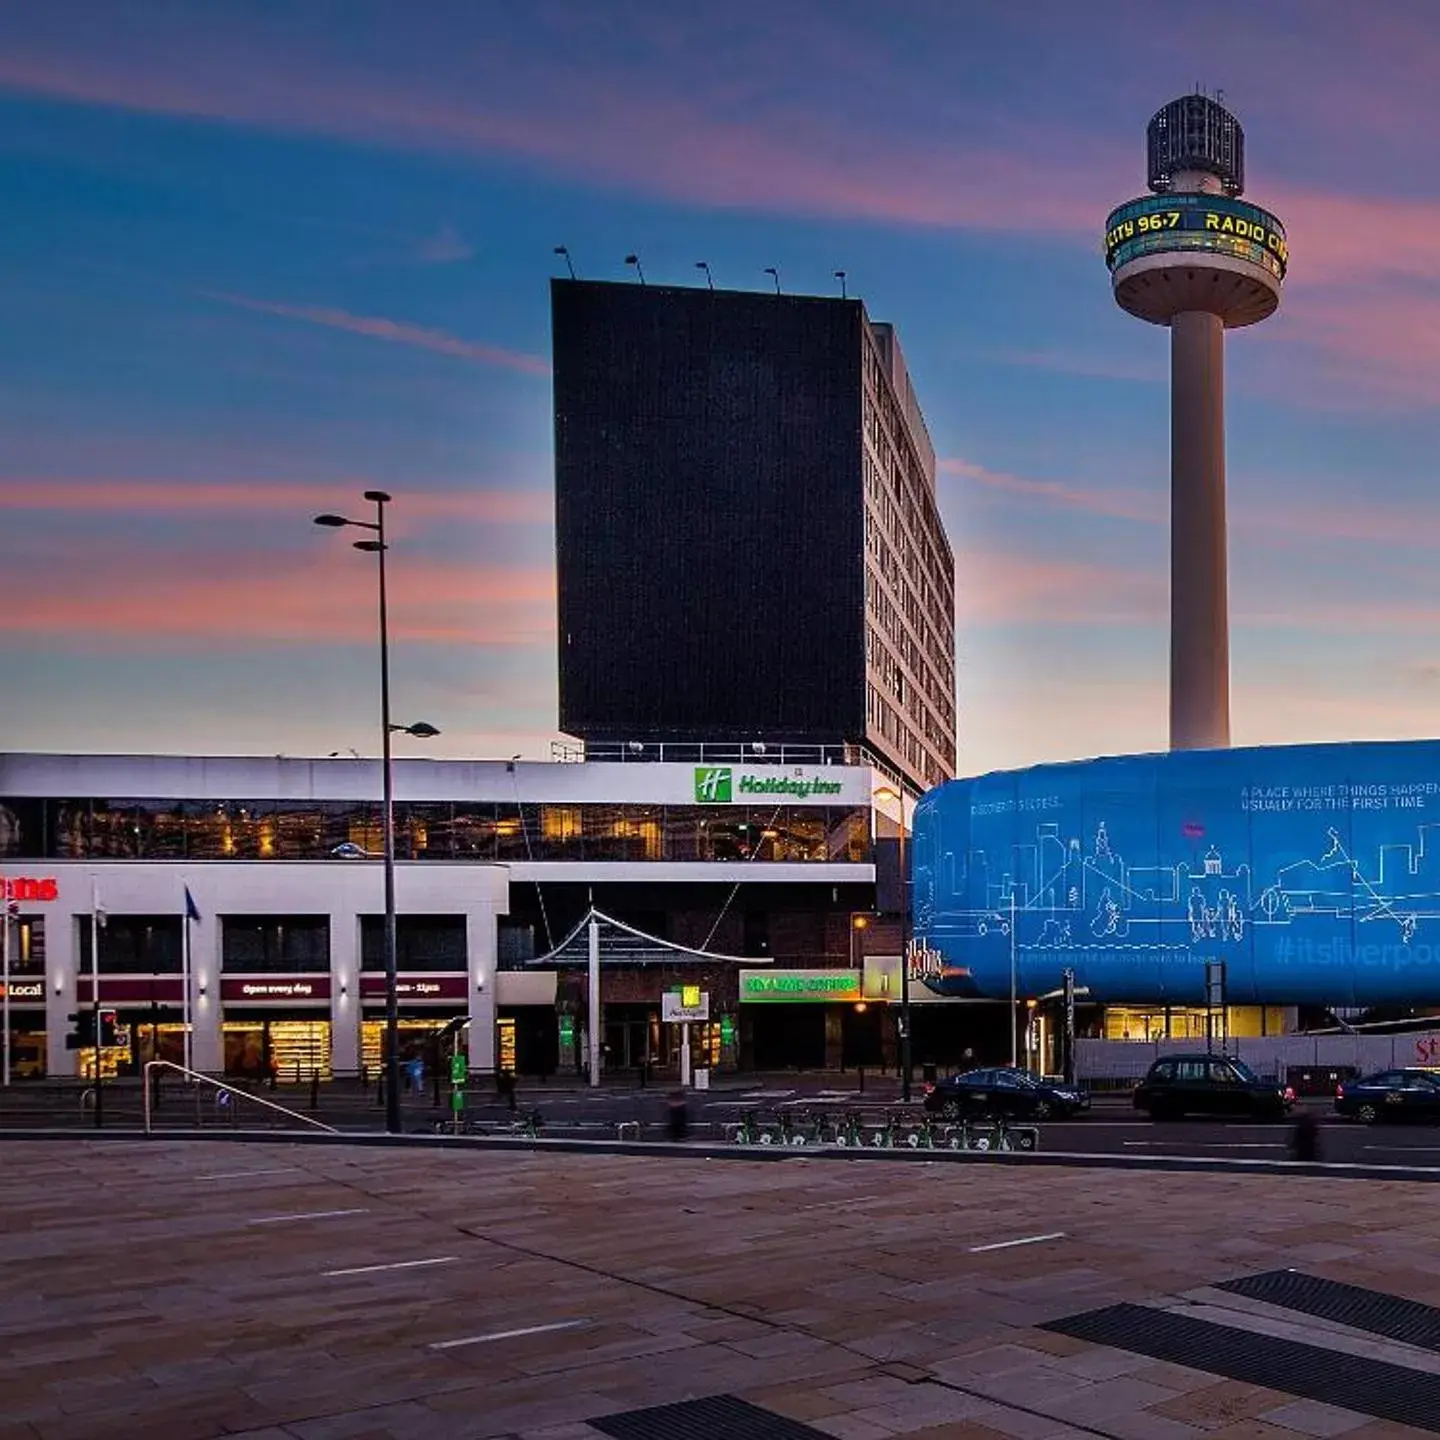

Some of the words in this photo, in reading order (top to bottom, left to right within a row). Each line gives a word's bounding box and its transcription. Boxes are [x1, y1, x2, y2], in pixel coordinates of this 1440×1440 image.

[1205, 213, 1265, 241] RADIO
[739, 775, 811, 799] Holiday
[812, 776, 843, 794] Inn
[1252, 786, 1290, 798] PLACE
[1292, 785, 1335, 798] WHERE
[1338, 784, 1387, 796] THINGS
[1241, 799, 1293, 811] USUALLY
[1296, 799, 1322, 810] FOR
[1324, 798, 1350, 810] THE
[1352, 798, 1389, 810] FIRST
[1394, 796, 1425, 808] TIME
[8, 983, 43, 996] Local
[242, 985, 268, 995] Open
[269, 985, 293, 996] every
[294, 983, 312, 995] day
[1416, 1038, 1439, 1062] St
